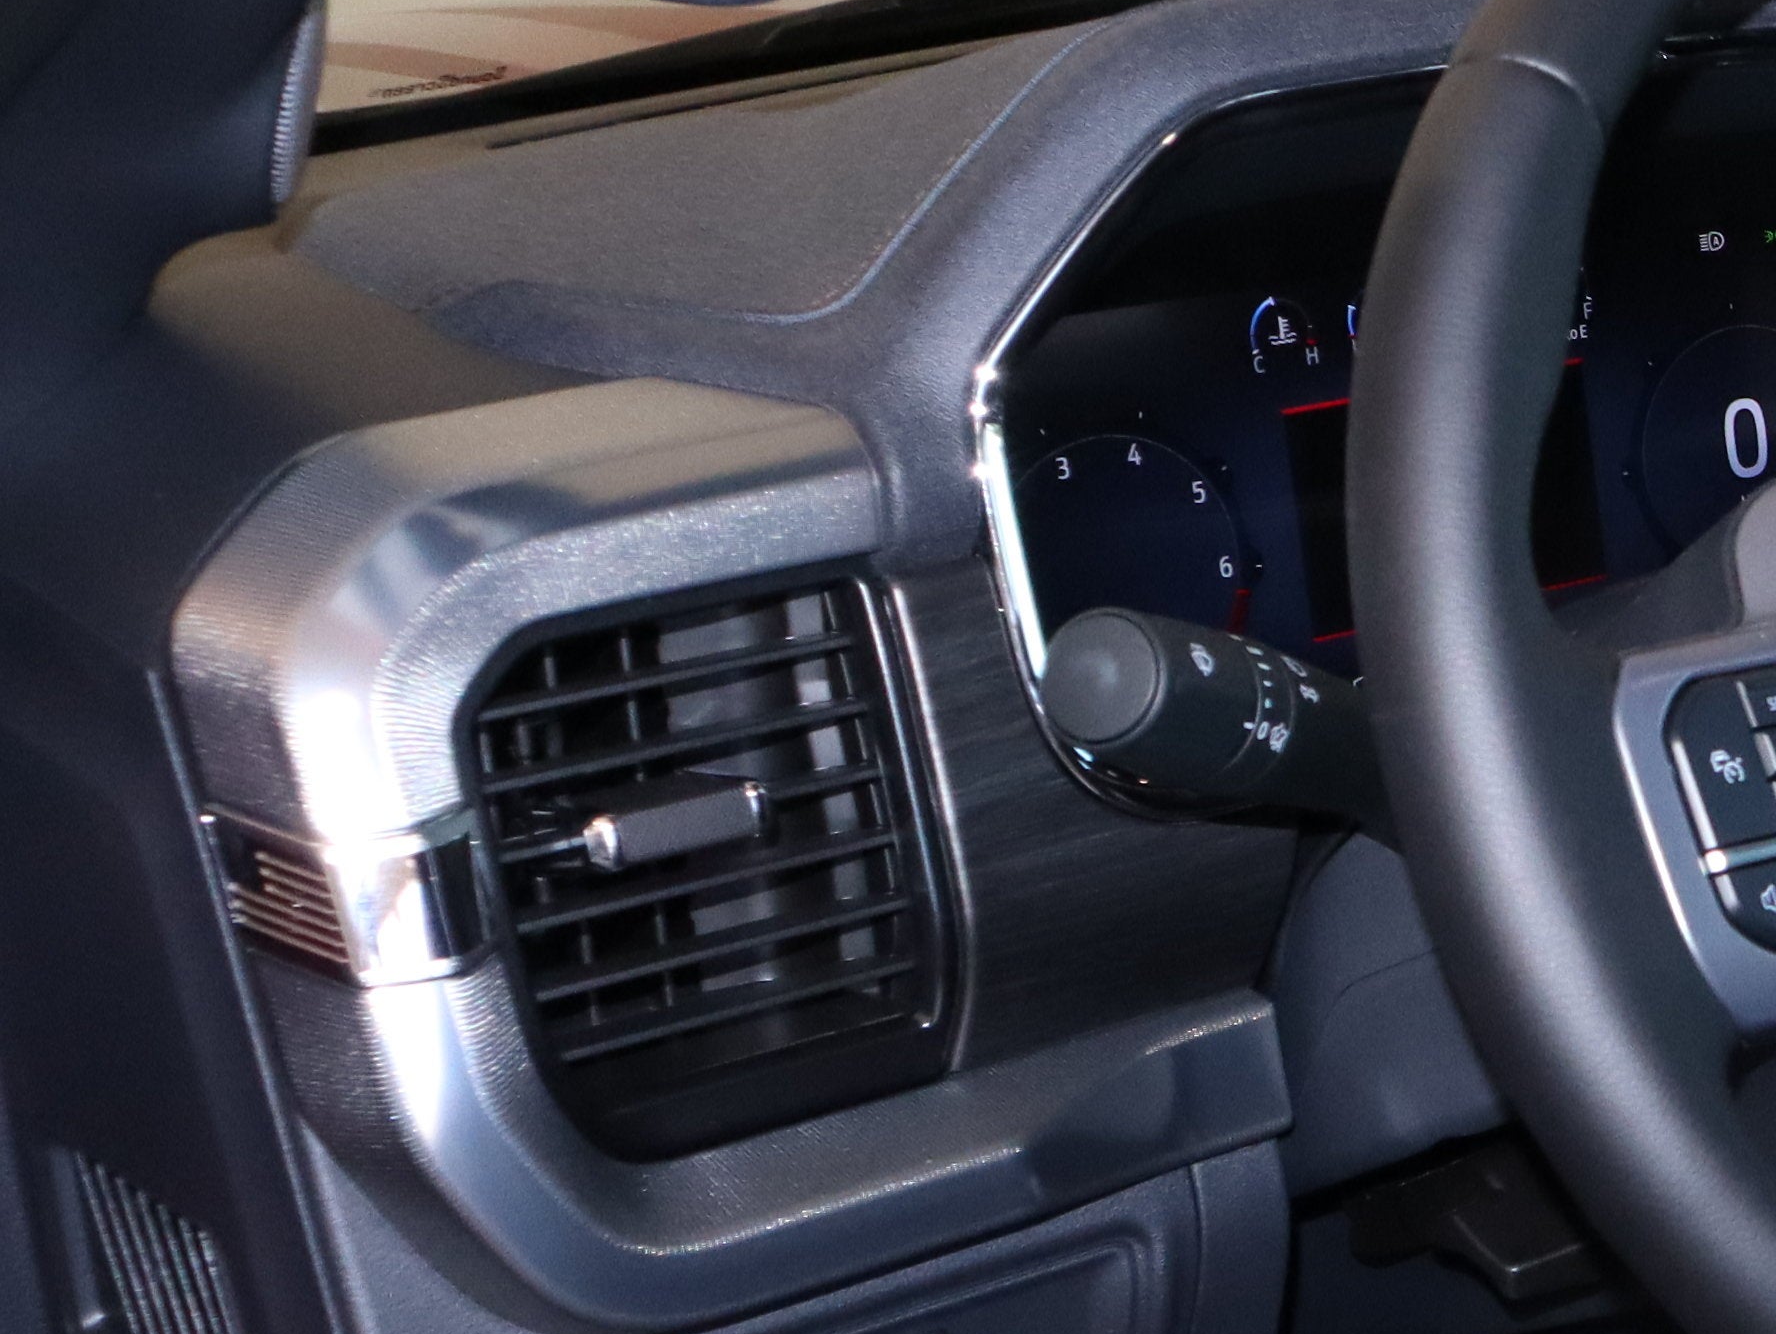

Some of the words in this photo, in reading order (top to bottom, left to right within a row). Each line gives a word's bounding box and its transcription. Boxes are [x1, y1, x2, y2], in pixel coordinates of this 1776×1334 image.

[1253, 356, 1266, 373] C
[1306, 347, 1320, 365] H
[1724, 398, 1769, 478] 0
[1127, 443, 1142, 465] 4
[1055, 457, 1070, 480] 3
[1192, 481, 1207, 503] 5
[1219, 556, 1234, 578] 6
